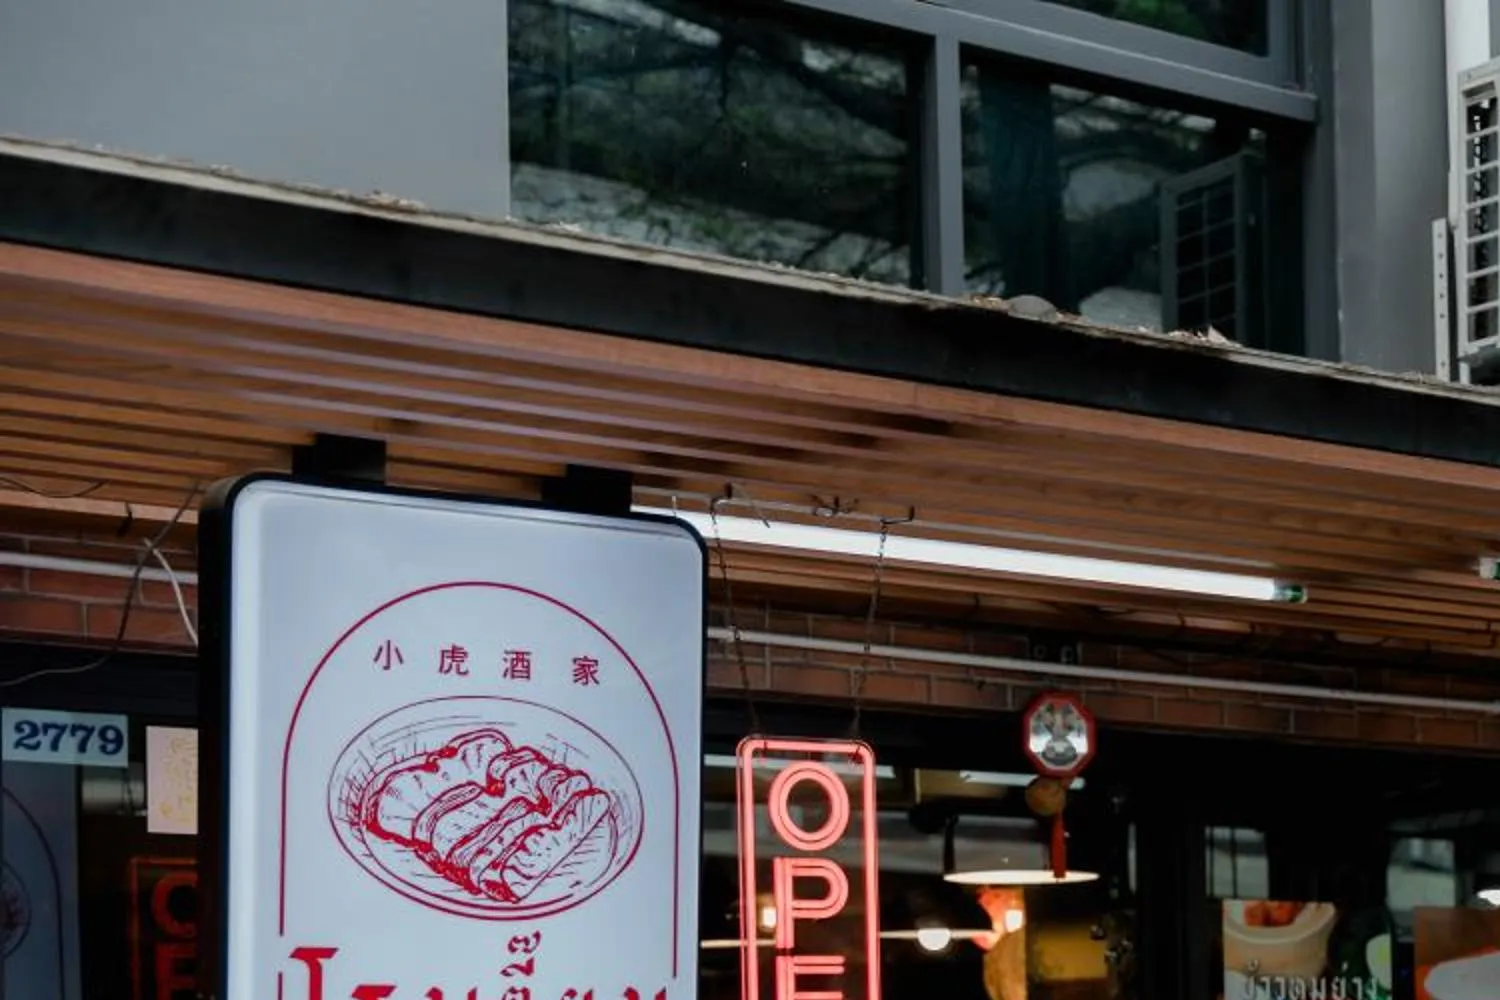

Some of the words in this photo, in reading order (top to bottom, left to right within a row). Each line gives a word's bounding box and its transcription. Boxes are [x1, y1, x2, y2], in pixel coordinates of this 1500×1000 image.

[374, 639, 601, 687] 小虎酒家
[13, 719, 124, 755] 2779
